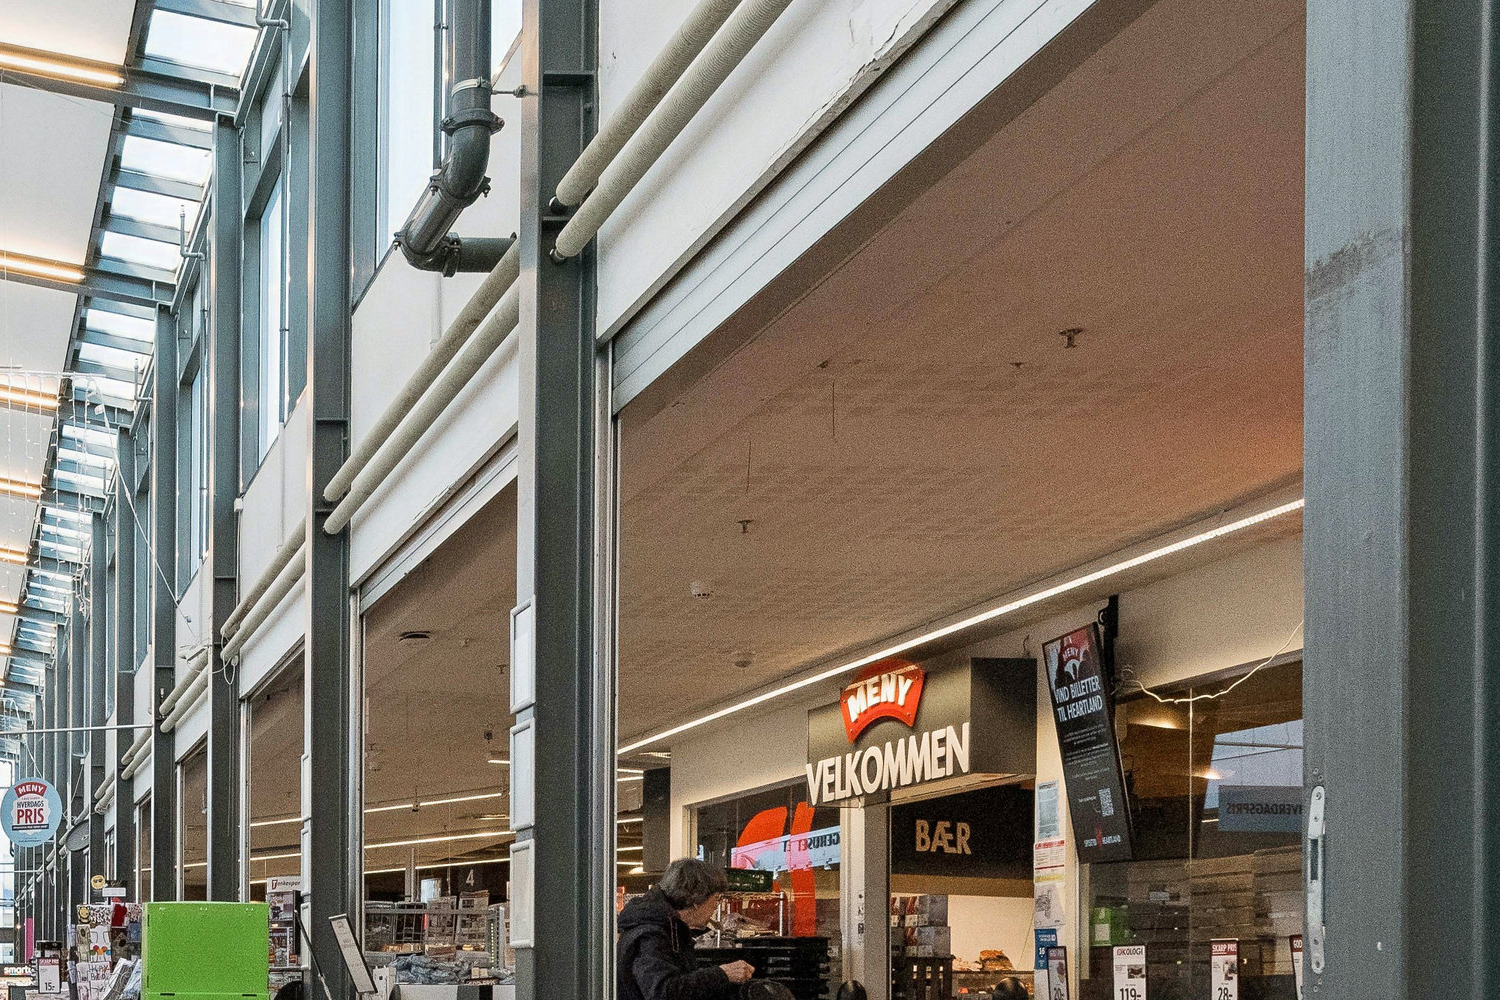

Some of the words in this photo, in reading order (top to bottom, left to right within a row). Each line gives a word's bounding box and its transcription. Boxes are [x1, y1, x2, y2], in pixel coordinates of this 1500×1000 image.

[847, 673, 914, 723] MENY
[805, 722, 970, 805] VELKOMMEN
[18, 784, 44, 795] MENY
[16, 800, 44, 808] HVERDAGS
[17, 808, 44, 824] PRIS
[916, 820, 972, 855] BÆR
[466, 870, 474, 886] 4
